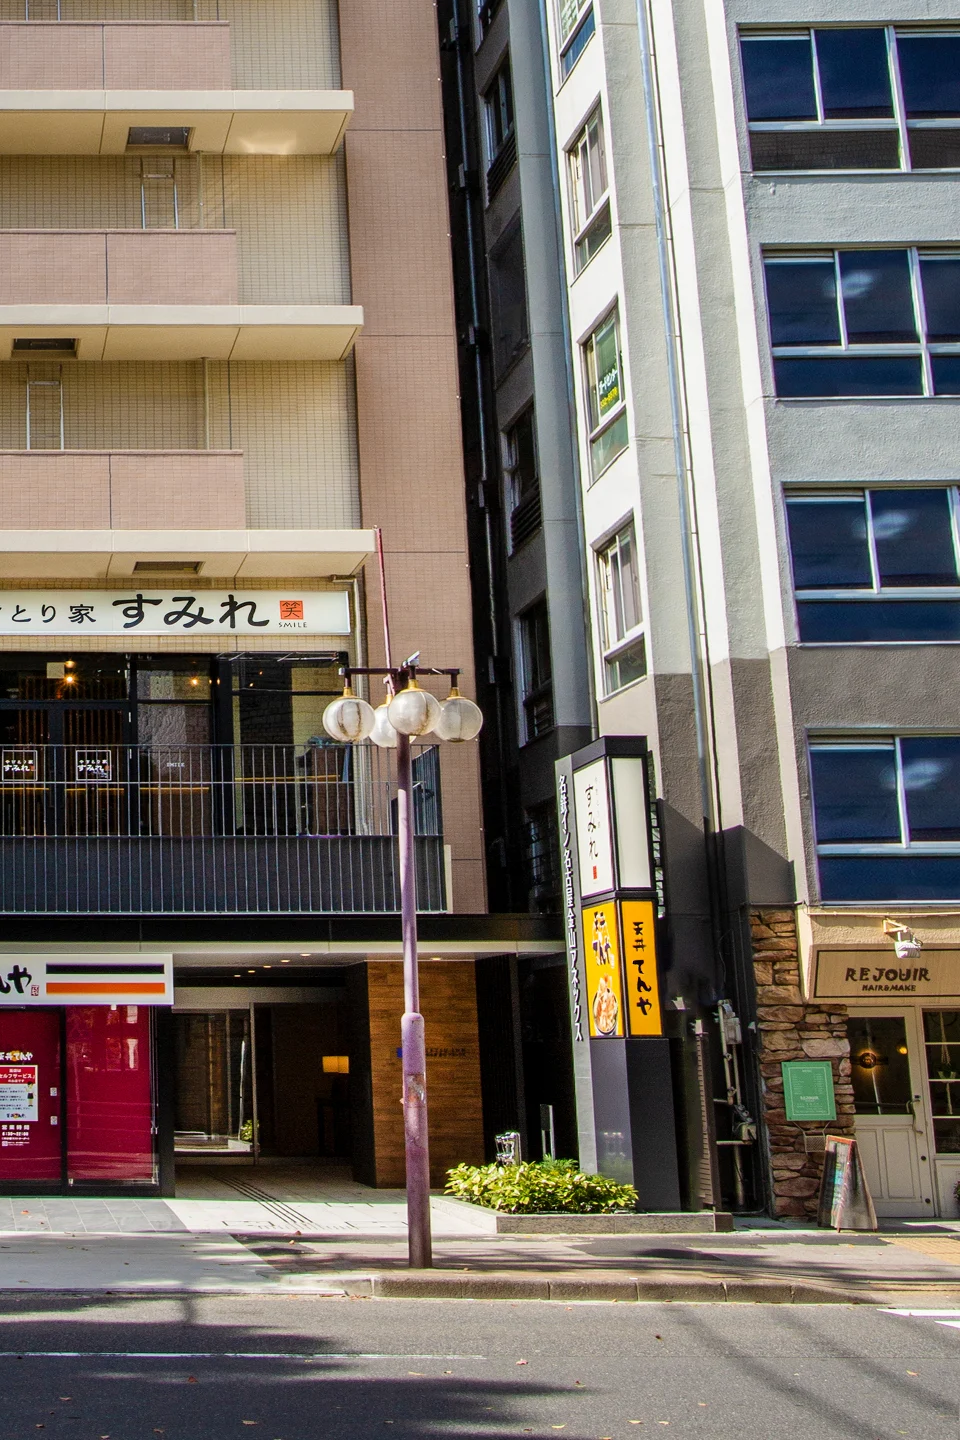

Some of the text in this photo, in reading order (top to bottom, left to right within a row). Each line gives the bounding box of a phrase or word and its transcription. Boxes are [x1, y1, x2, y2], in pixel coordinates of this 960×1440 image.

[112, 593, 270, 629] すみれ
[585, 783, 599, 860] すみれ
[559, 773, 584, 1042] 名鉄イン名古屋金山アネックス
